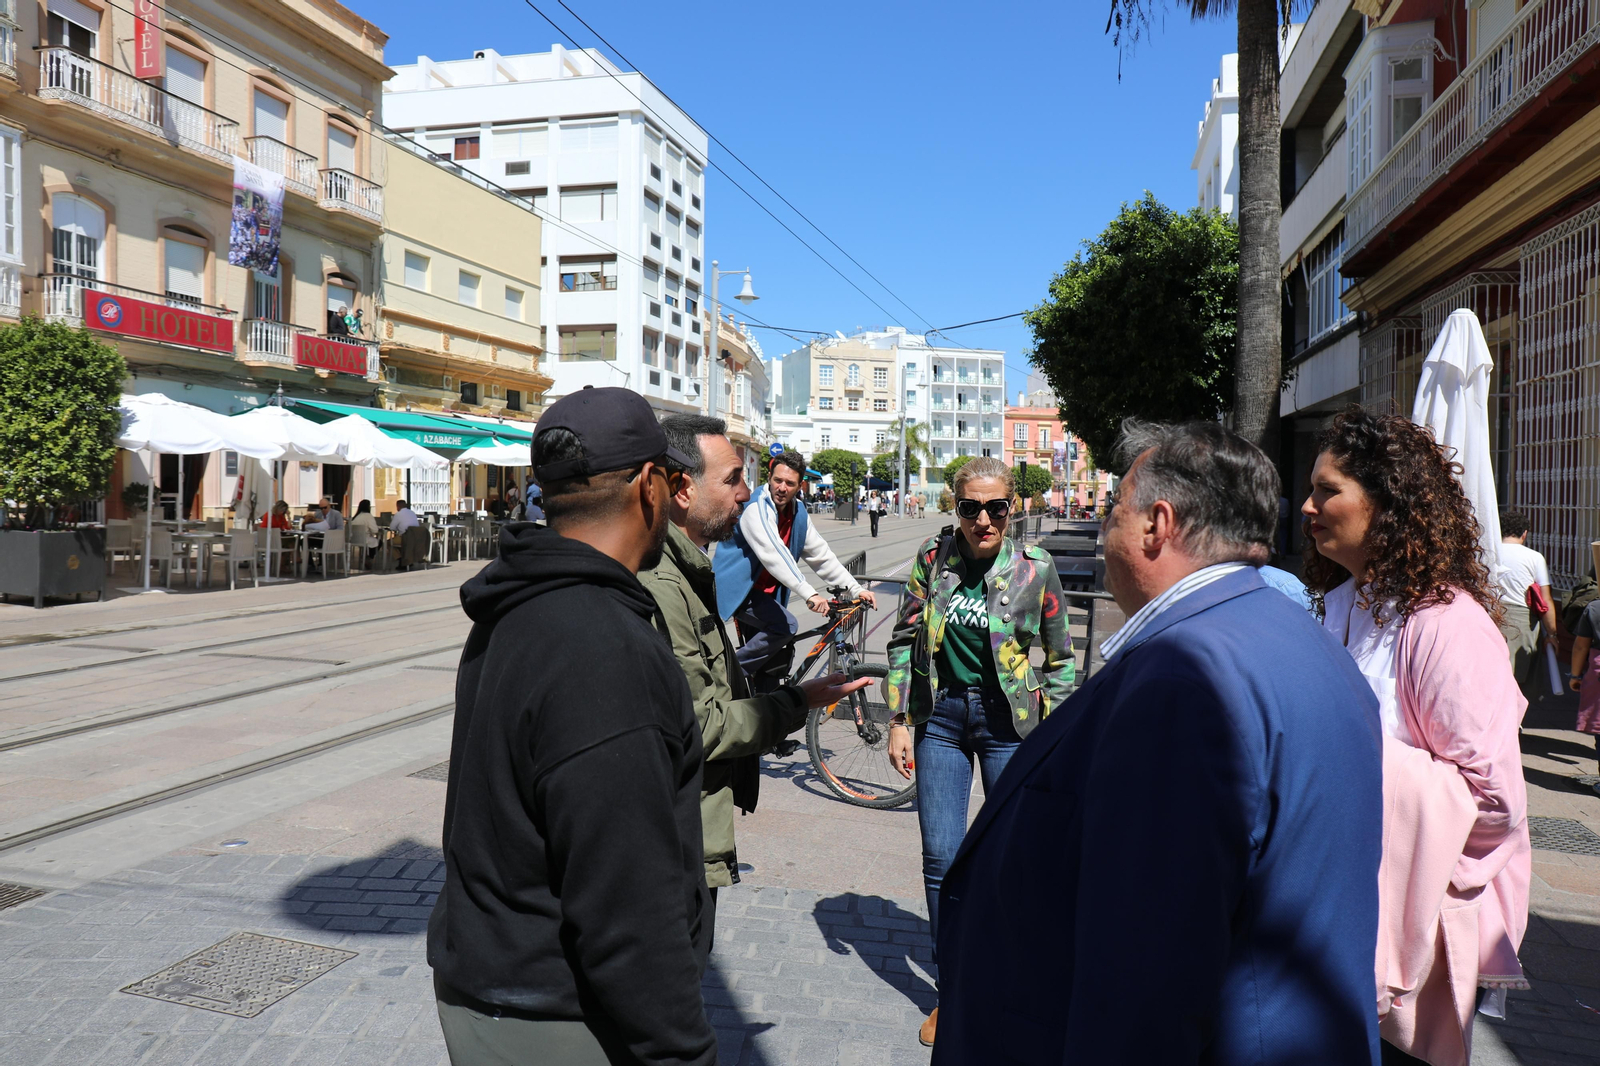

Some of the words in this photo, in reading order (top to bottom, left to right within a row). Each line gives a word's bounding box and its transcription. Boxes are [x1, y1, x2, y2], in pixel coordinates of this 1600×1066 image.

[139, 305, 226, 346] HOTEL
[301, 339, 358, 369] ROMA
[423, 434, 462, 446] AZABACHE
